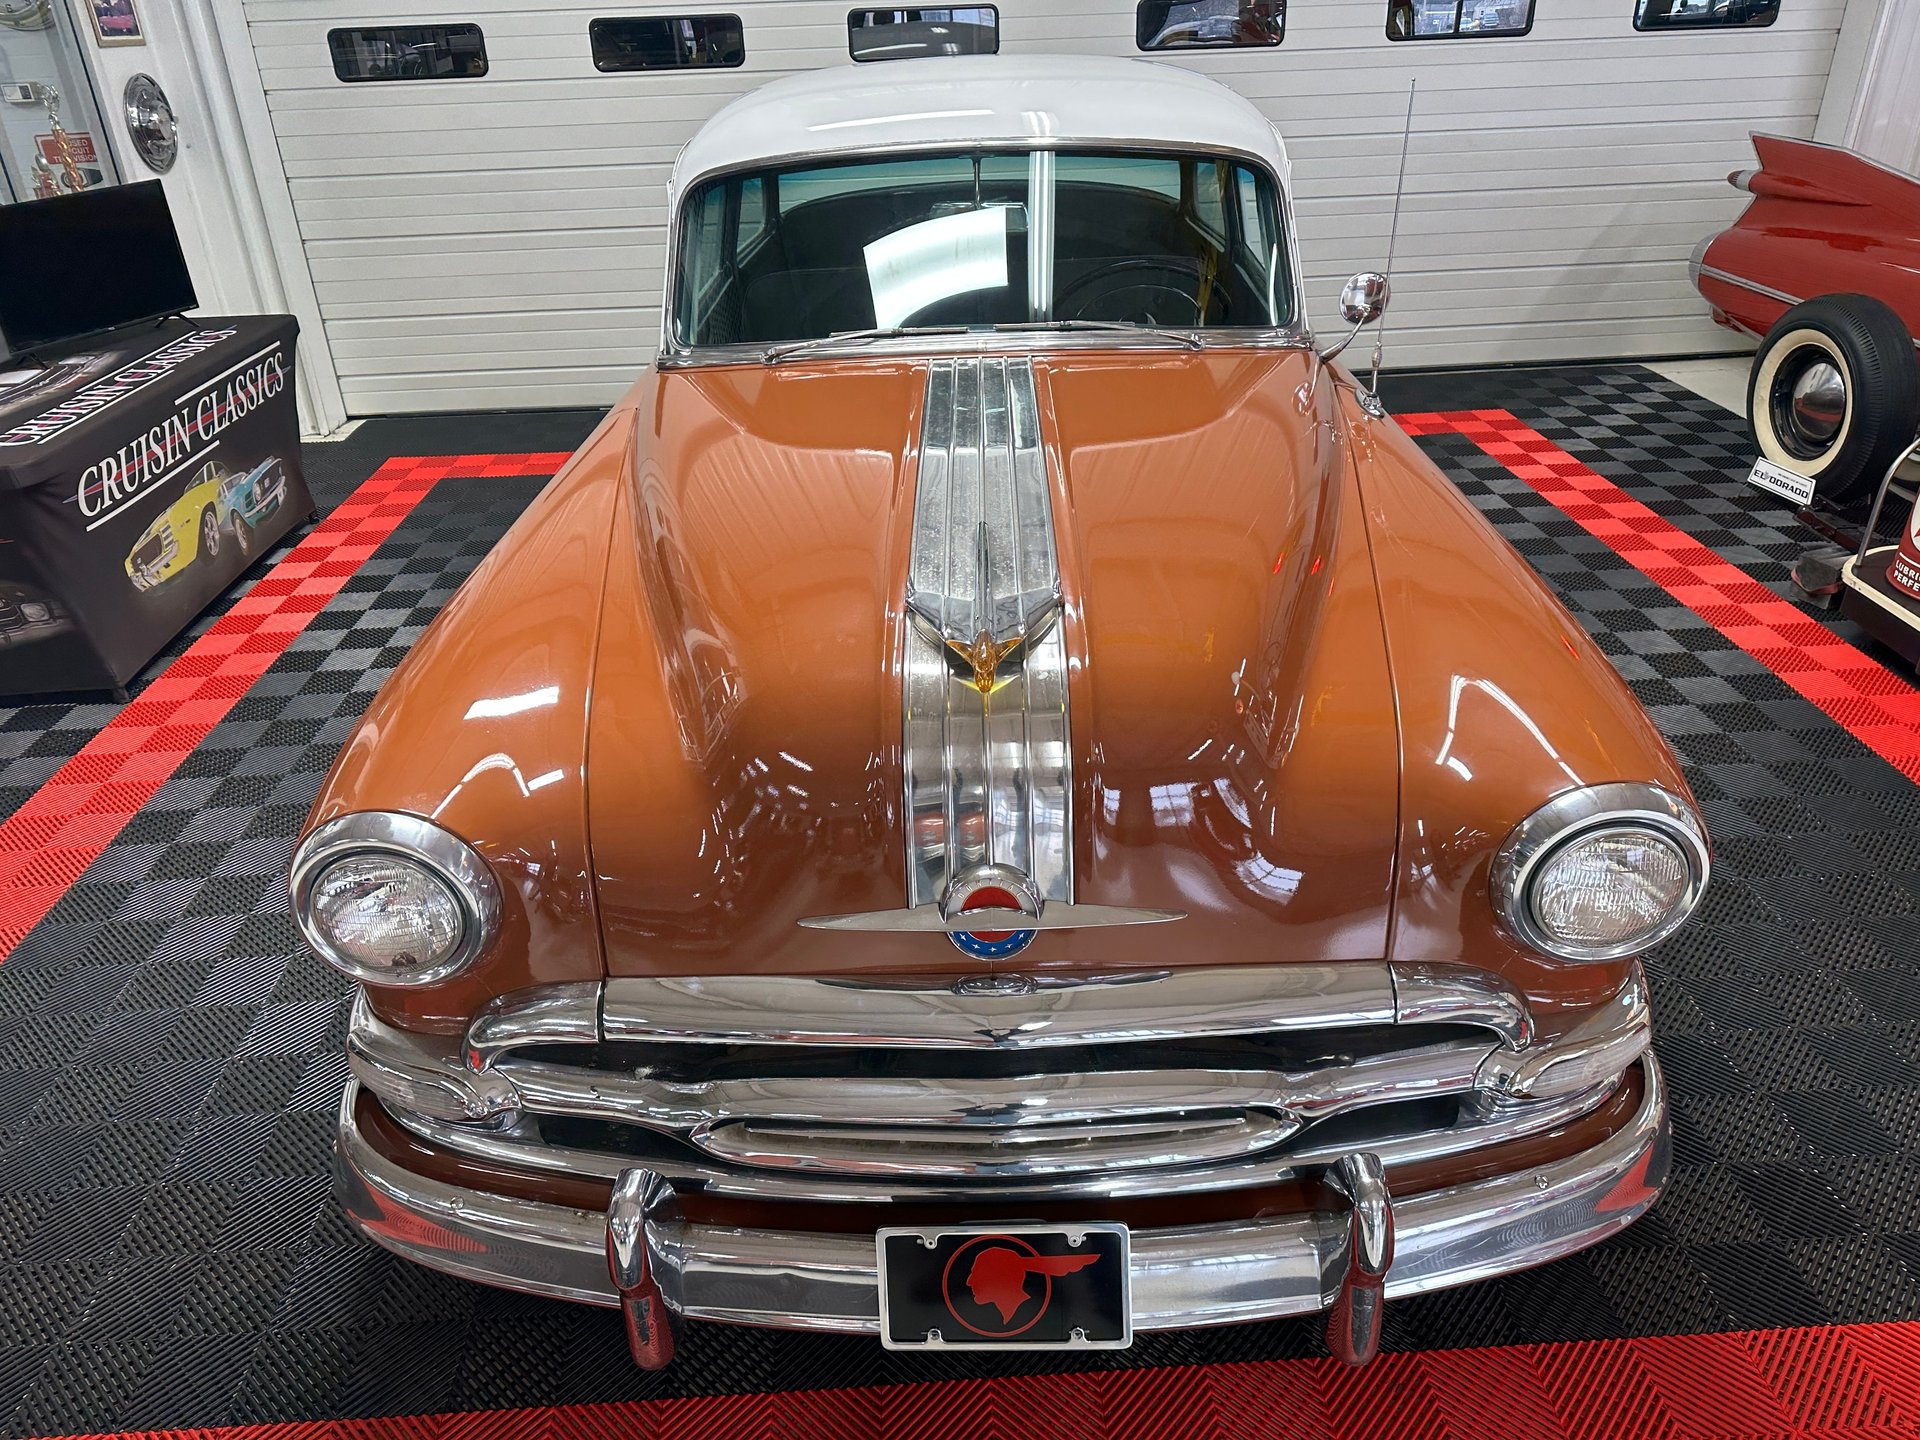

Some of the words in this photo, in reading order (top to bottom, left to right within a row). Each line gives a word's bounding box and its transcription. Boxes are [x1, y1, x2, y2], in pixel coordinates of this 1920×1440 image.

[0, 384, 134, 446] CRUISIN
[113, 330, 237, 374] CLASSICS
[77, 408, 191, 517] CRUISIN
[196, 351, 284, 442] CLASSICS
[1895, 560, 1920, 581] LUBRI
